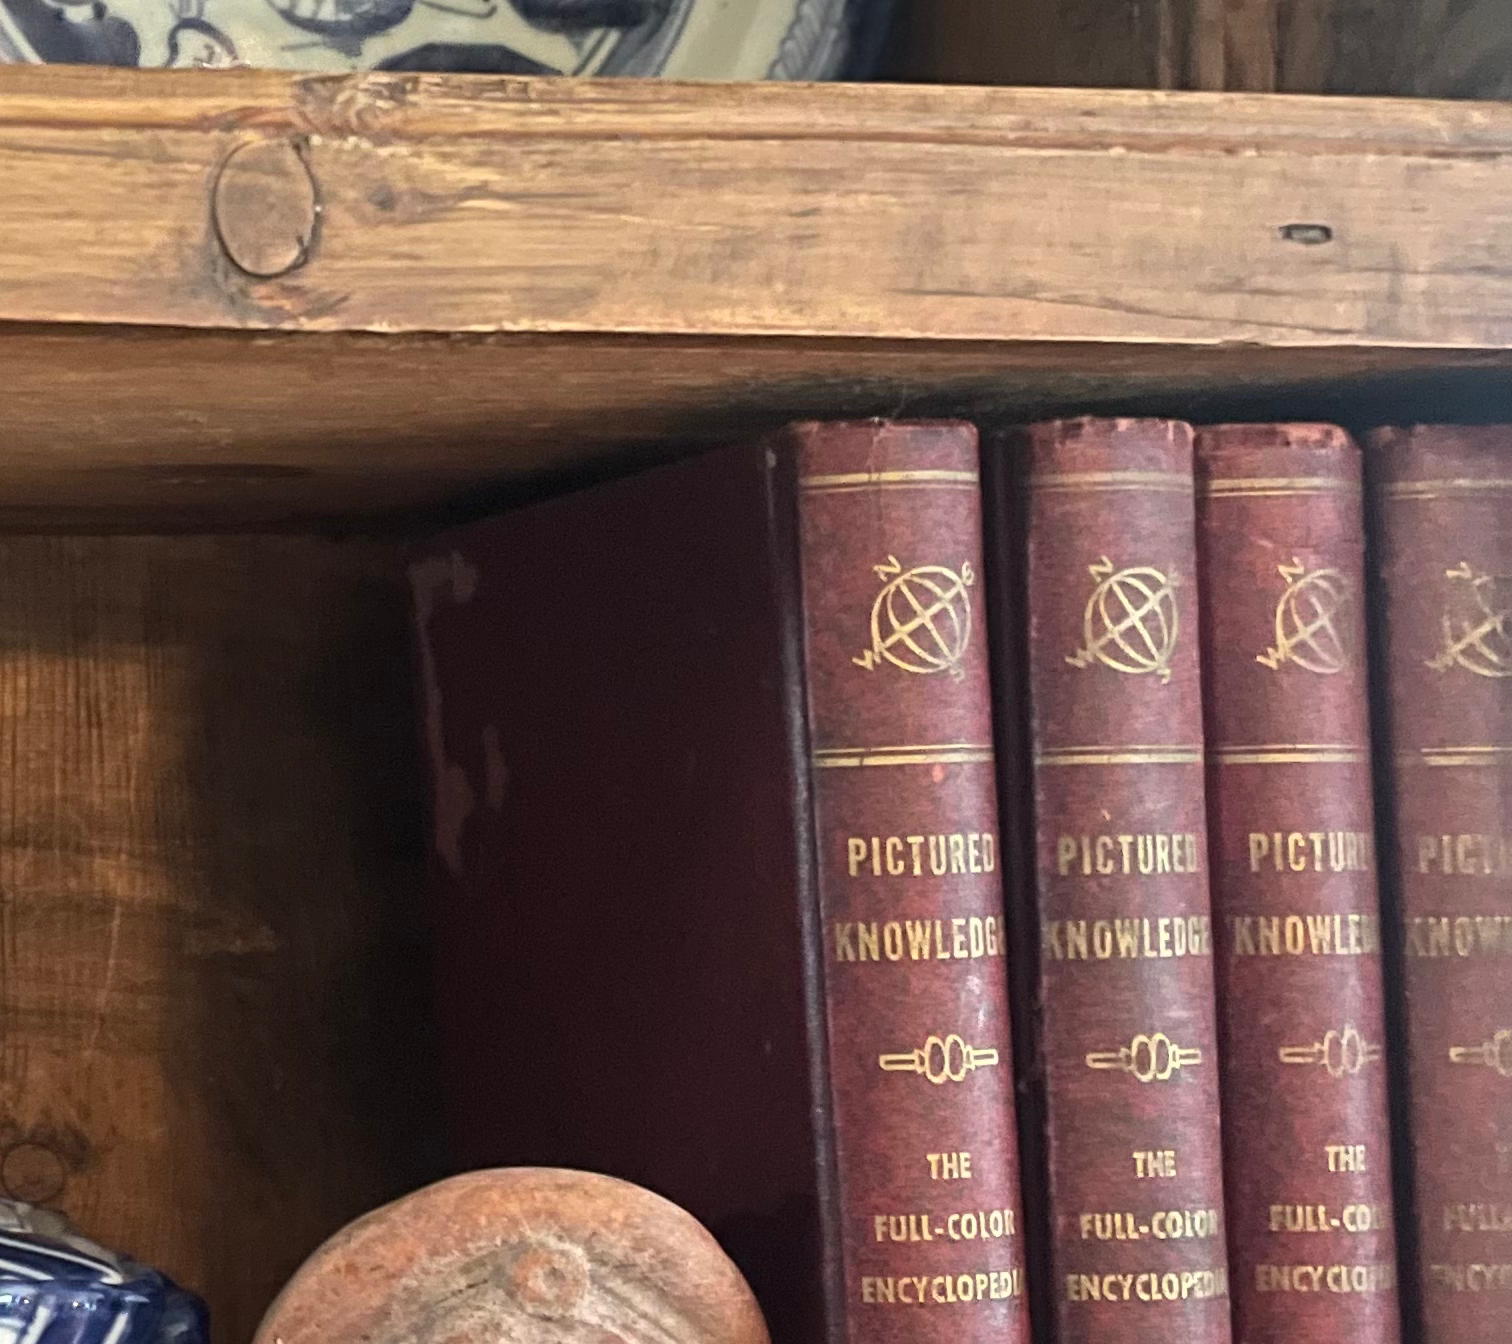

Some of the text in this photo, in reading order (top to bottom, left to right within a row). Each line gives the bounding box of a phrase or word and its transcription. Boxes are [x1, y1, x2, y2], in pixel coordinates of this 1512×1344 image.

[847, 833, 995, 877] PICTURED
[1057, 832, 1198, 876] PICTURED
[1043, 915, 1213, 962] KNOWLEDGE
[927, 1151, 972, 1180] THE
[1132, 1150, 1177, 1179] THE
[1325, 1144, 1366, 1172] THE
[875, 1209, 1016, 1243] FULL-COLOR
[1080, 1208, 1219, 1241] FULL-COLOR
[862, 1267, 1024, 1305] ENCYCLOPEDI
